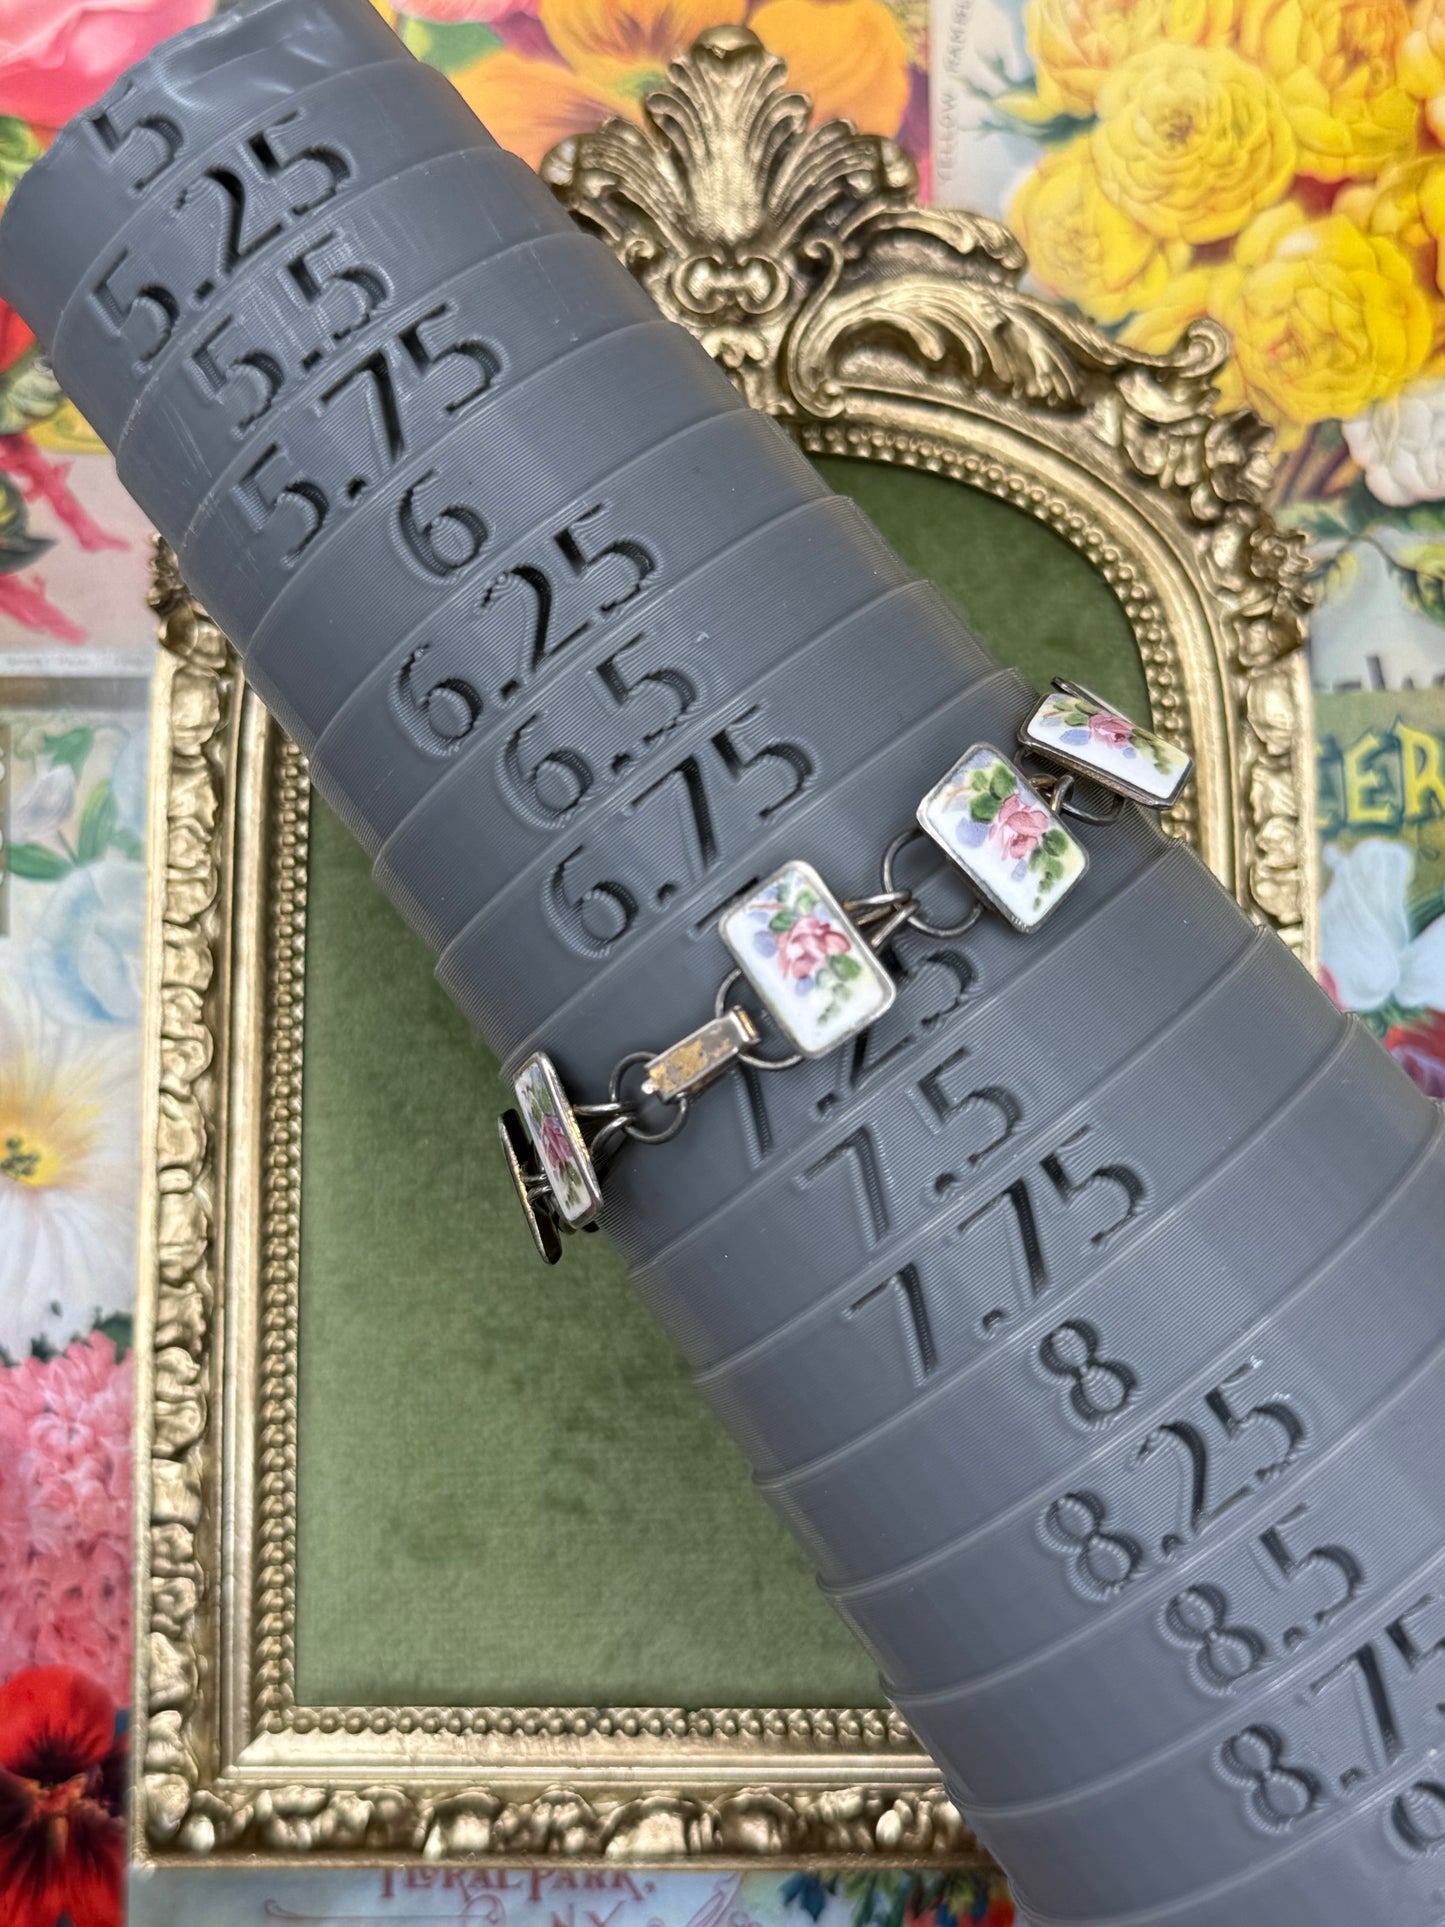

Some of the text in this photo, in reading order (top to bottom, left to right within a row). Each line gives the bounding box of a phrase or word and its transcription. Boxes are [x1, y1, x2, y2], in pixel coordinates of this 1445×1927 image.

[85, 83, 186, 192] 5
[91, 110, 354, 372] 5.25
[189, 230, 394, 438] 5.5
[234, 303, 506, 566] 5.75
[390, 468, 492, 585] 6
[391, 502, 662, 758] 6.25
[498, 630, 700, 830] 6.5
[543, 703, 820, 957] 6.75
[1316, 718, 1445, 836] ER
[794, 1046, 1026, 1250] 7.5
[842, 1124, 1150, 1385] 7.75
[1031, 1318, 1139, 1430] 8
[1036, 1355, 1309, 1600] 8.25
[1157, 1502, 1366, 1696] 8.5
